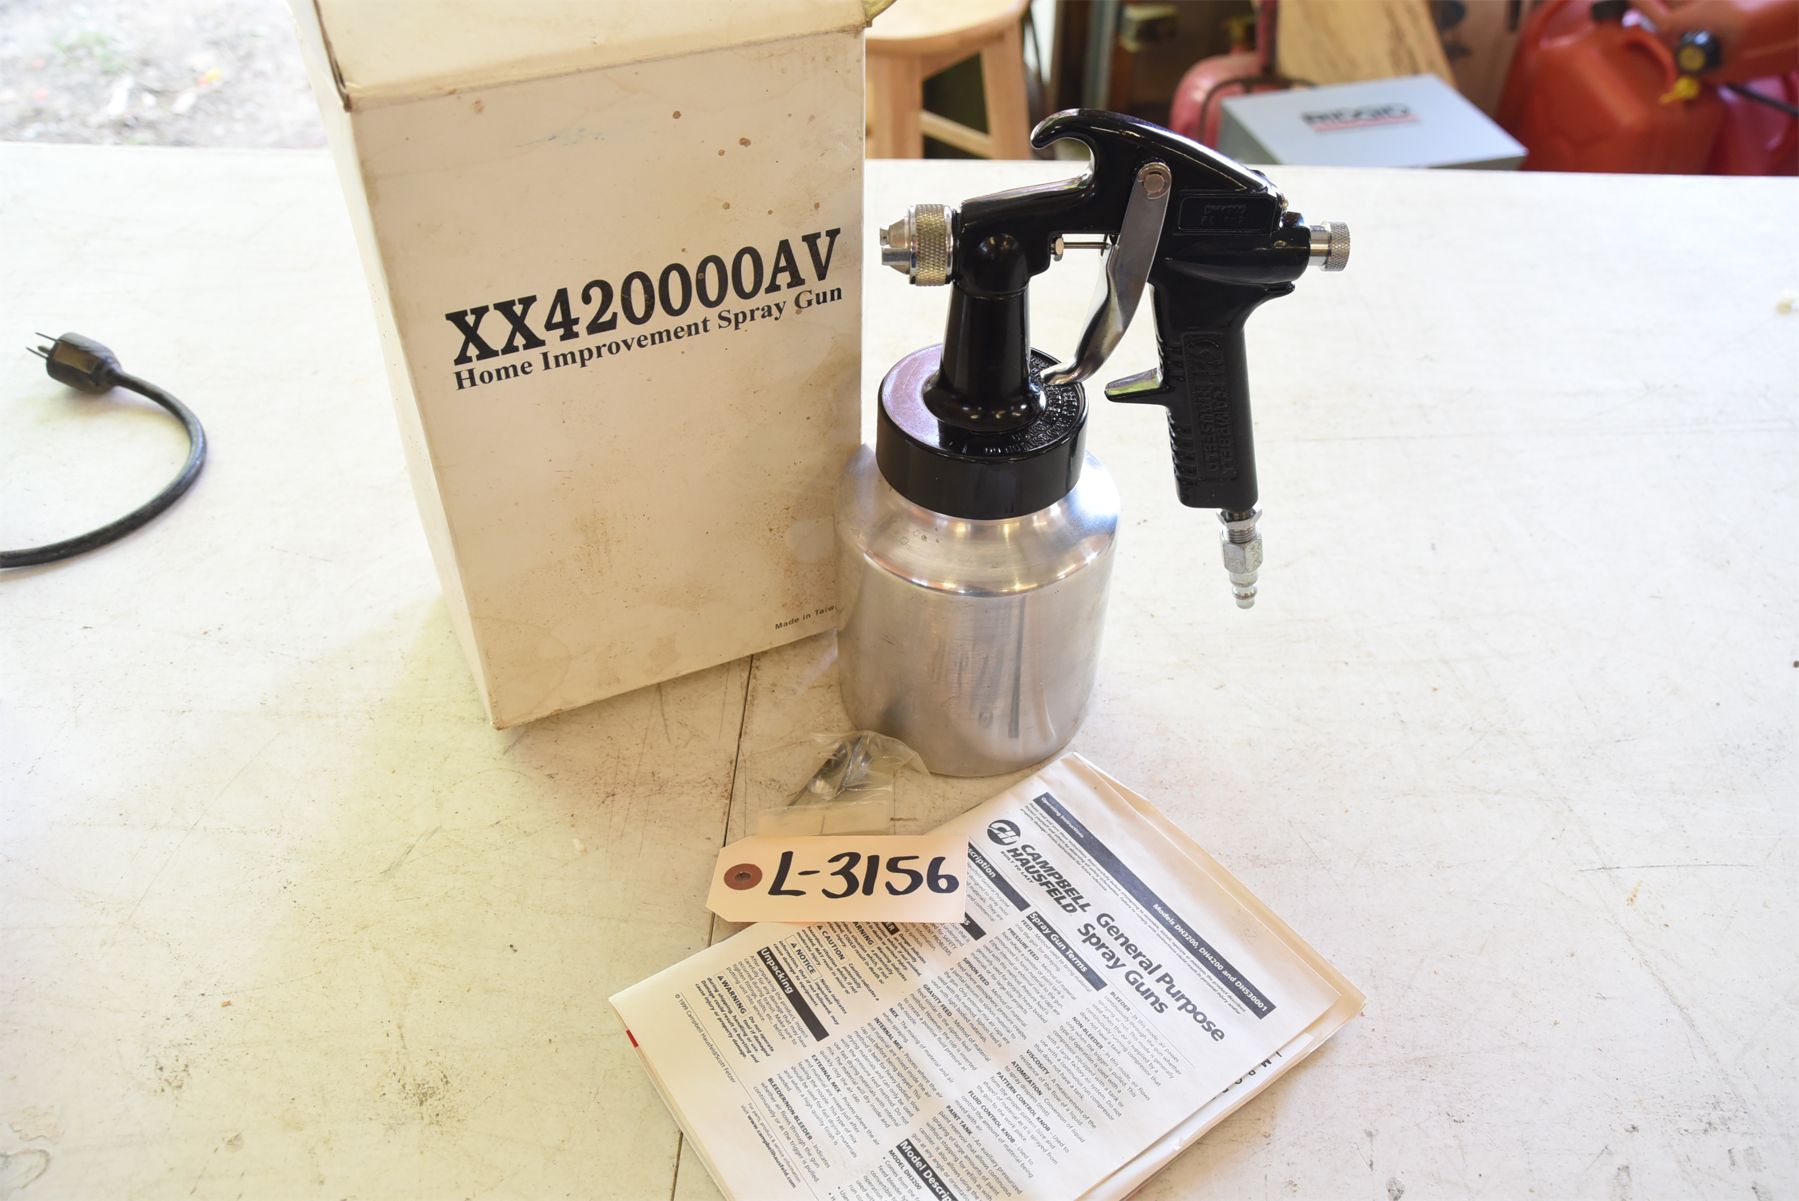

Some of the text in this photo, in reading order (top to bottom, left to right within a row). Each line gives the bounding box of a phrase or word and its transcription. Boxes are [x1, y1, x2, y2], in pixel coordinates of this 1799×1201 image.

[445, 228, 841, 366] XX420000AV
[453, 286, 843, 391] Home Improvement Spray Gun
[775, 618, 799, 630] Made
[814, 605, 837, 615] Taiw
[768, 850, 959, 899] L-3156
[966, 848, 996, 877] scription
[1005, 845, 1078, 915] HAUSFELD
[1019, 842, 1093, 912] CAMPBELL
[794, 948, 816, 974] NOTICE
[820, 930, 846, 960] CAUTION
[852, 920, 874, 945] ARNING
[1007, 927, 1039, 960] PRESSURE FEED
[1020, 919, 1032, 931] FEED
[1034, 933, 1050, 949] Method
[1049, 949, 1060, 959] used
[1063, 963, 1075, 976] bring
[1074, 975, 1092, 992] material
[1029, 912, 1087, 972] Spray Gun Terms
[1075, 921, 1127, 974] Spray
[1121, 967, 1169, 1014] Guns
[1152, 903, 1175, 925] Models
[1173, 924, 1199, 949] DH3200,
[1198, 947, 1224, 970] DH4200
[1222, 969, 1236, 982] and
[1234, 980, 1267, 1011] DH530001
[721, 979, 747, 1014] WARNING
[749, 954, 808, 1038] After unpacking the product, inspect
[760, 948, 794, 994] Unpacking
[962, 957, 979, 974] SIPHON
[977, 973, 989, 986] FEED
[990, 988, 1007, 1005] Method
[1010, 1009, 1027, 1027] material
[1092, 911, 1161, 975] General
[1154, 971, 1227, 1042] Purpose
[1109, 991, 1130, 1011] BLEEDER
[678, 998, 688, 1010] 1999
[685, 1010, 703, 1033] Campbell
[700, 1032, 725, 1067] Hausfeld/Scott
[723, 1067, 735, 1083] Fetzer
[866, 1022, 876, 1031] and
[874, 1031, 891, 1048] material
[888, 1048, 896, 1056] are
[895, 1056, 908, 1070] mixed
[906, 1069, 918, 1083] inside
[917, 1082, 925, 1091] the
[873, 1017, 894, 1040] INTERNAL
[892, 1039, 902, 1050] MIX
[903, 1052, 918, 1069] Process
[916, 1069, 929, 1083] where
[928, 1083, 936, 1092] the
[888, 1007, 898, 1017] MIX
[899, 1020, 908, 1029] The
[906, 1029, 920, 1044] mixing
[923, 1049, 940, 1067] material
[938, 1067, 948, 1077] and
[922, 983, 941, 1004] GRAVITY
[939, 1003, 952, 1017] FEED
[953, 1019, 970, 1037] Method
[972, 1043, 991, 1062] material
[1058, 1025, 1068, 1036] type
[1072, 1041, 1094, 1063] operation
[1096, 1067, 1109, 1079] used
[1106, 1078, 1119, 1089] with
[1071, 1016, 1103, 1049] NON-BLEEDER
[853, 1030, 870, 1048] method
[871, 1051, 881, 1062] best
[884, 1069, 897, 1084] heavy
[895, 1082, 910, 1101] bodied,
[909, 1101, 920, 1112] slow
[860, 1026, 920, 1099] cap just before being sprayed. This
[1010, 1060, 1042, 1095] ATOMIZATION
[1025, 1049, 1049, 1075] VISCOSITY
[1054, 1083, 1083, 1114] measurement
[1087, 1119, 1096, 1129] the
[1064, 1021, 1074, 1032] only
[1073, 1031, 1086, 1044] when
[1085, 1043, 1094, 1052] the
[1093, 1051, 1108, 1067] trigger
[1110, 1071, 1126, 1086] pulled.
[1126, 1087, 1136, 1097] This
[767, 1077, 812, 1141] BLEEDER/NON-BLEEDER
[811, 1054, 832, 1081] EXTERNAL
[830, 1081, 841, 1093] MIX
[841, 1096, 855, 1114] Process
[854, 1113, 867, 1130] where
[865, 1129, 873, 1139] the
[967, 1090, 1015, 1143] FLUID CONTROL KNOB
[995, 1071, 1050, 1131] PATTERN CONTROL KNOB
[888, 1149, 921, 1190] MODEL DH3200
[899, 1140, 926, 1171] Model
[937, 1111, 1011, 1197] paint reservoir that allows continuous
[945, 1105, 1022, 1194] PAINT TANK An auxiliary pressurized
